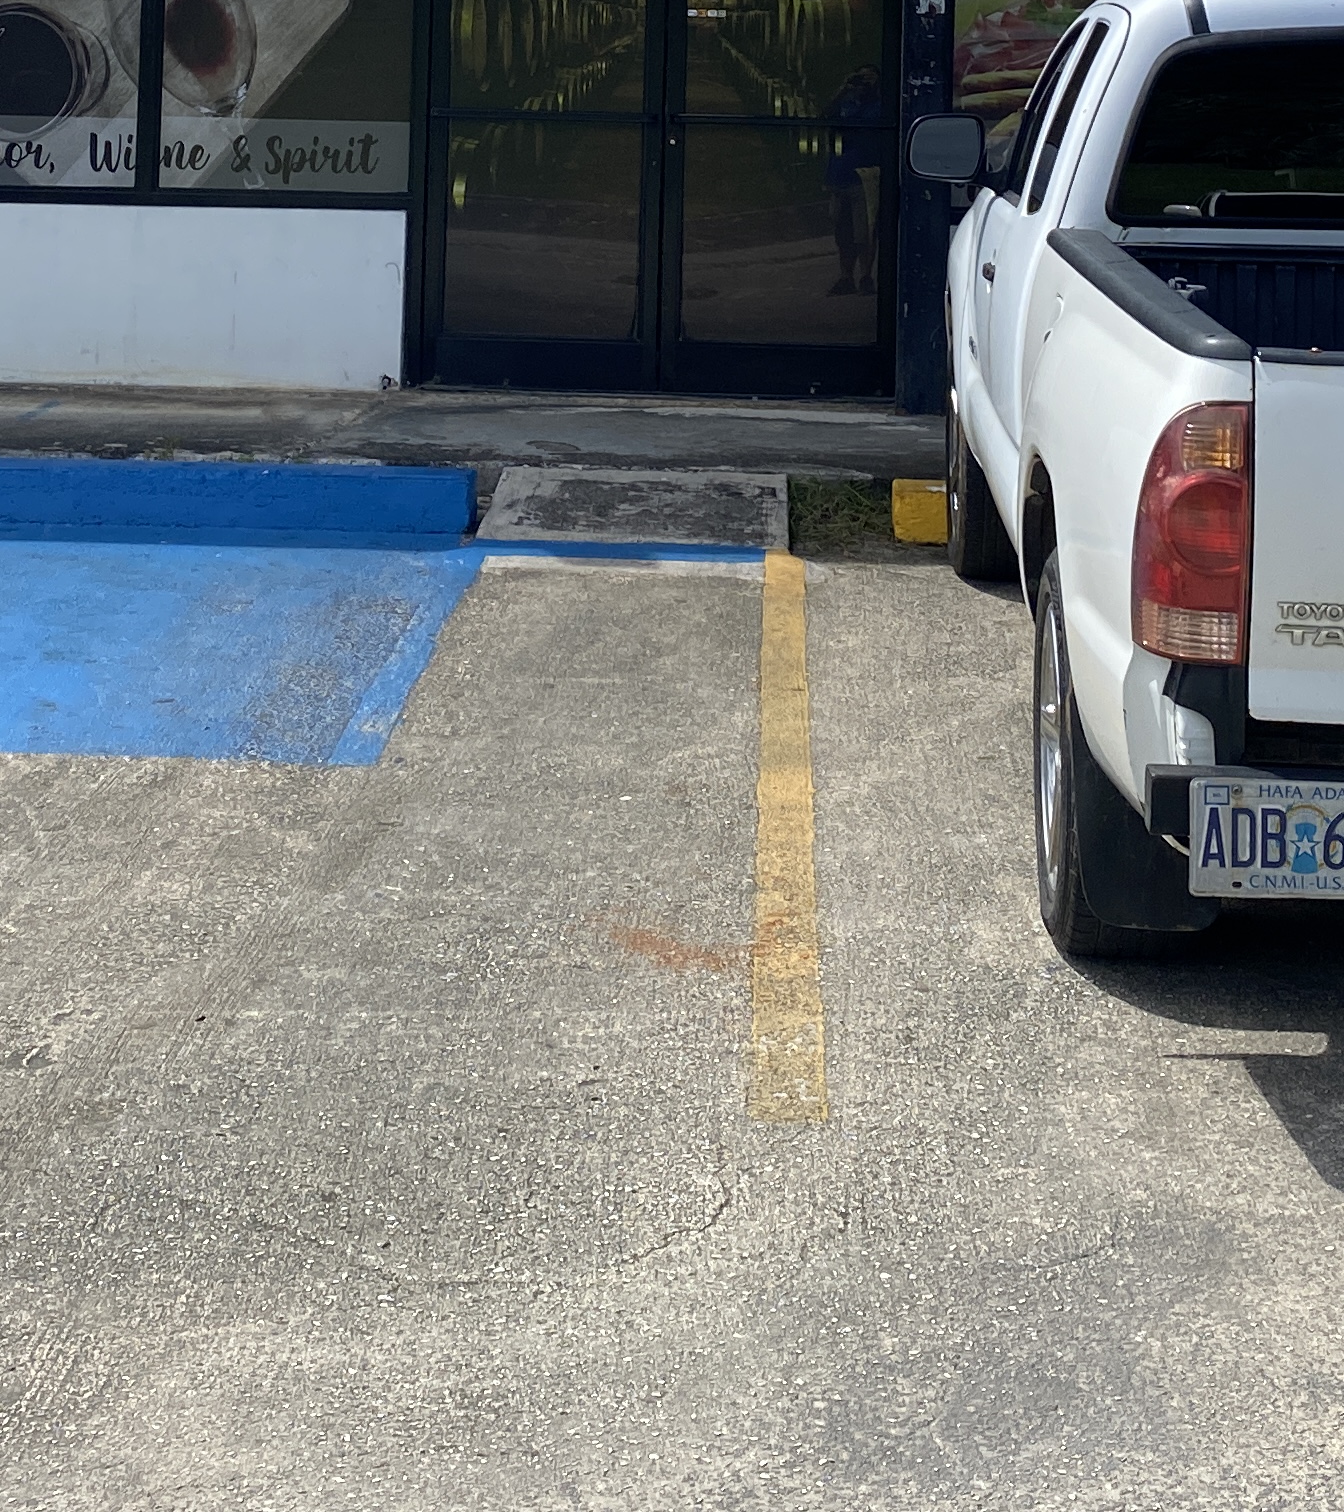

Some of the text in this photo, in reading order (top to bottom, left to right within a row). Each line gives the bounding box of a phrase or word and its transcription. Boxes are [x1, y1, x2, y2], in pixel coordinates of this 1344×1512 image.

[230, 134, 252, 174] &
[264, 132, 381, 185] Spirit
[1258, 784, 1304, 800] HAFA
[1201, 807, 1288, 869] ADB
